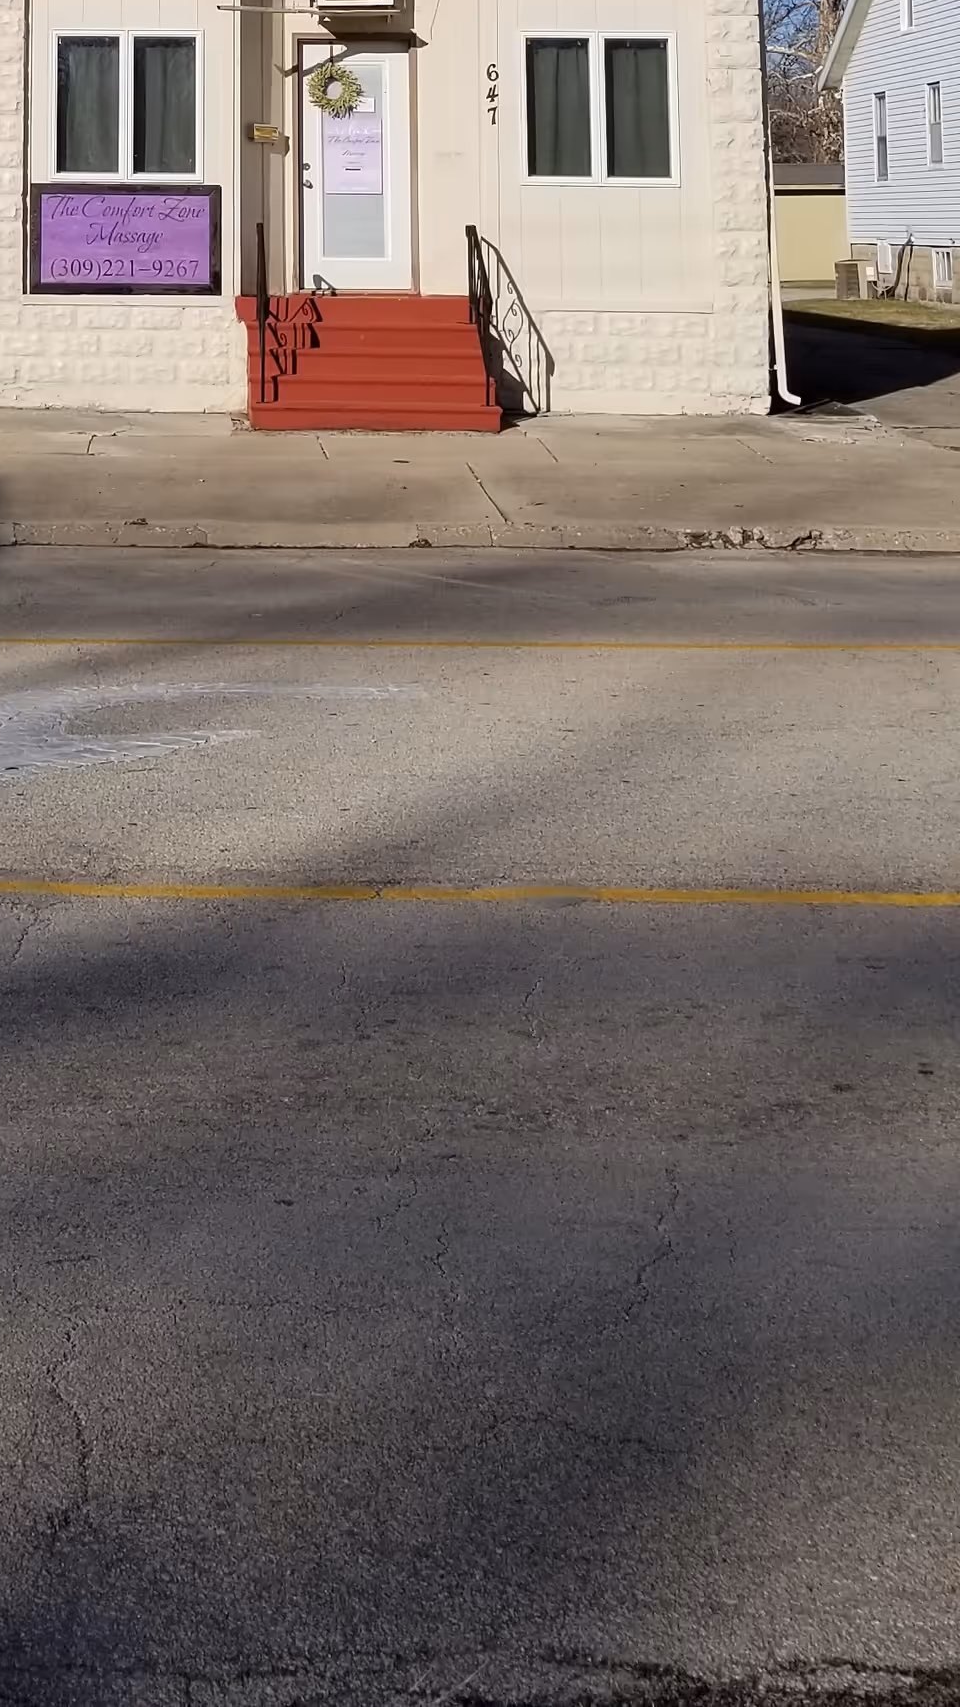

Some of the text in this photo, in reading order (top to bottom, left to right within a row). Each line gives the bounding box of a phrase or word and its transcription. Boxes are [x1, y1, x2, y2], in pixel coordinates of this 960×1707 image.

[486, 63, 499, 125] 647
[46, 195, 205, 226] The Comfort Zone
[86, 221, 164, 253] Massage
[50, 258, 199, 280] (309)221-9267
